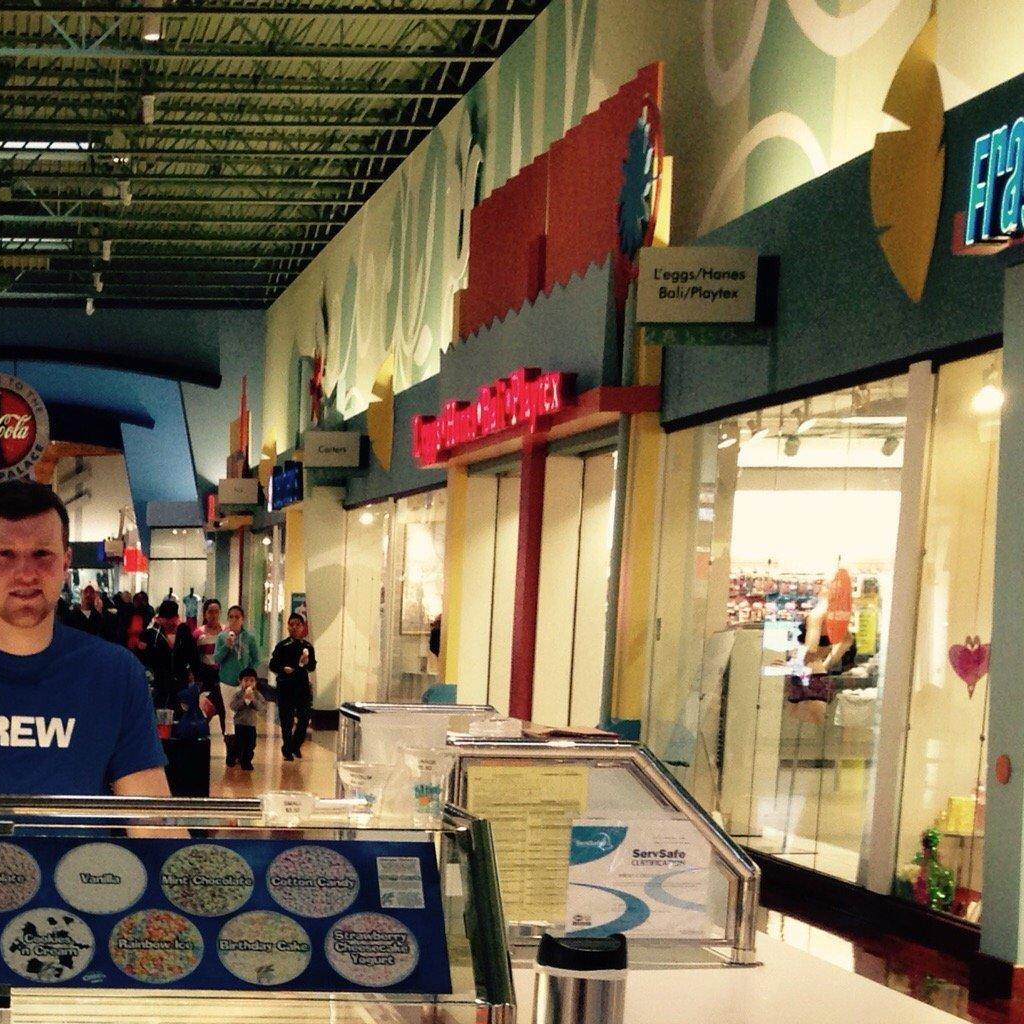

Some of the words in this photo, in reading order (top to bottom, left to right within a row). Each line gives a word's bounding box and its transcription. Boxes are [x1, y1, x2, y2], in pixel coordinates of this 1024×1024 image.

[965, 117, 1024, 245] Fra
[659, 286, 739, 302] Bali/Playtex
[632, 849, 686, 859] ServSafe
[79, 872, 122, 885] Vanilla
[162, 875, 190, 886] Mint
[192, 875, 253, 887] Chocolate
[270, 876, 315, 888] Cotton
[316, 876, 356, 889] Candy
[24, 932, 73, 945] Cookies
[333, 930, 408, 943] Strawberry
[117, 938, 171, 950] Rainbow
[173, 939, 193, 950] Ice
[218, 939, 275, 952] Birthday
[277, 940, 310, 952] Cake
[333, 942, 409, 954] Cheesecake
[34, 945, 80, 957] Cream
[350, 954, 395, 966] Yogurt
